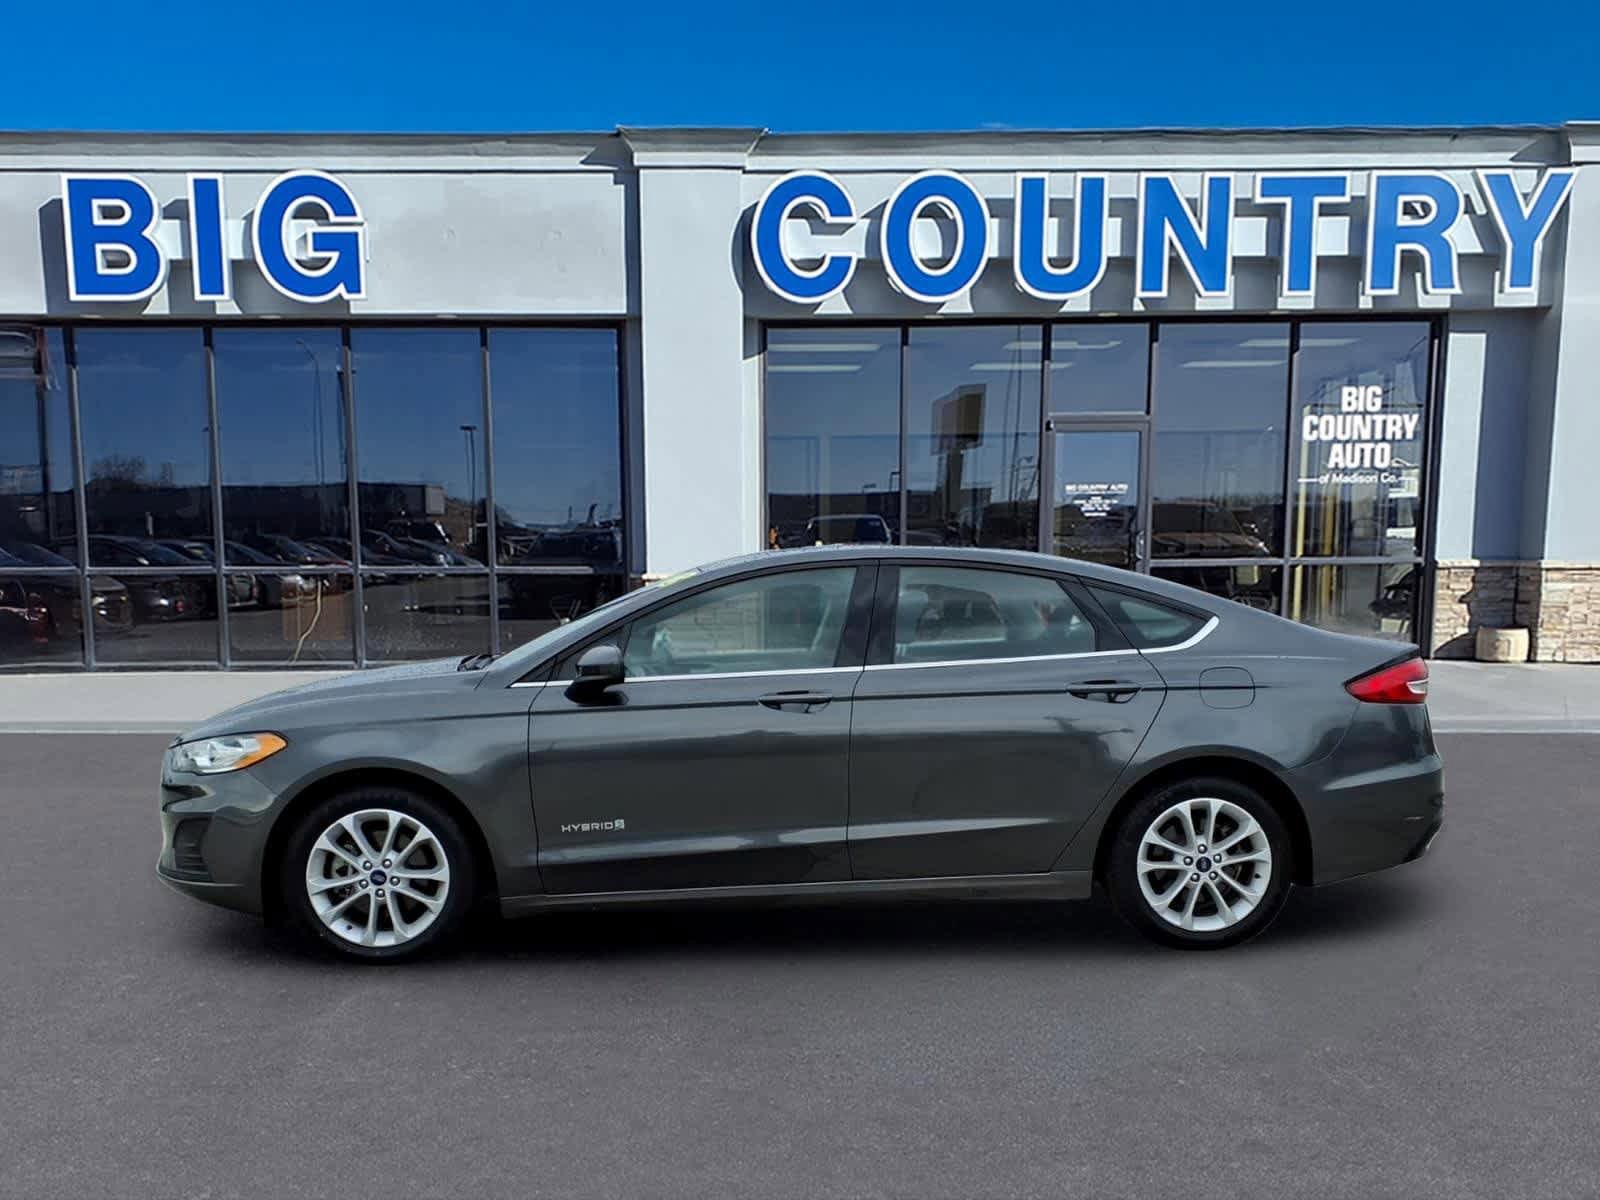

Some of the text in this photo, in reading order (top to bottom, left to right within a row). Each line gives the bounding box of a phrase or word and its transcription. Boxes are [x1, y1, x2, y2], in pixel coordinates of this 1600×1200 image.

[61, 169, 1573, 303] BIG COUNTRY
[1341, 385, 1382, 413] BIG
[1302, 413, 1419, 441] COUNTRY
[1327, 442, 1391, 469] AUTO
[1319, 472, 1330, 484] of
[1331, 472, 1378, 484] Madison
[561, 822, 613, 832] HYBRID
